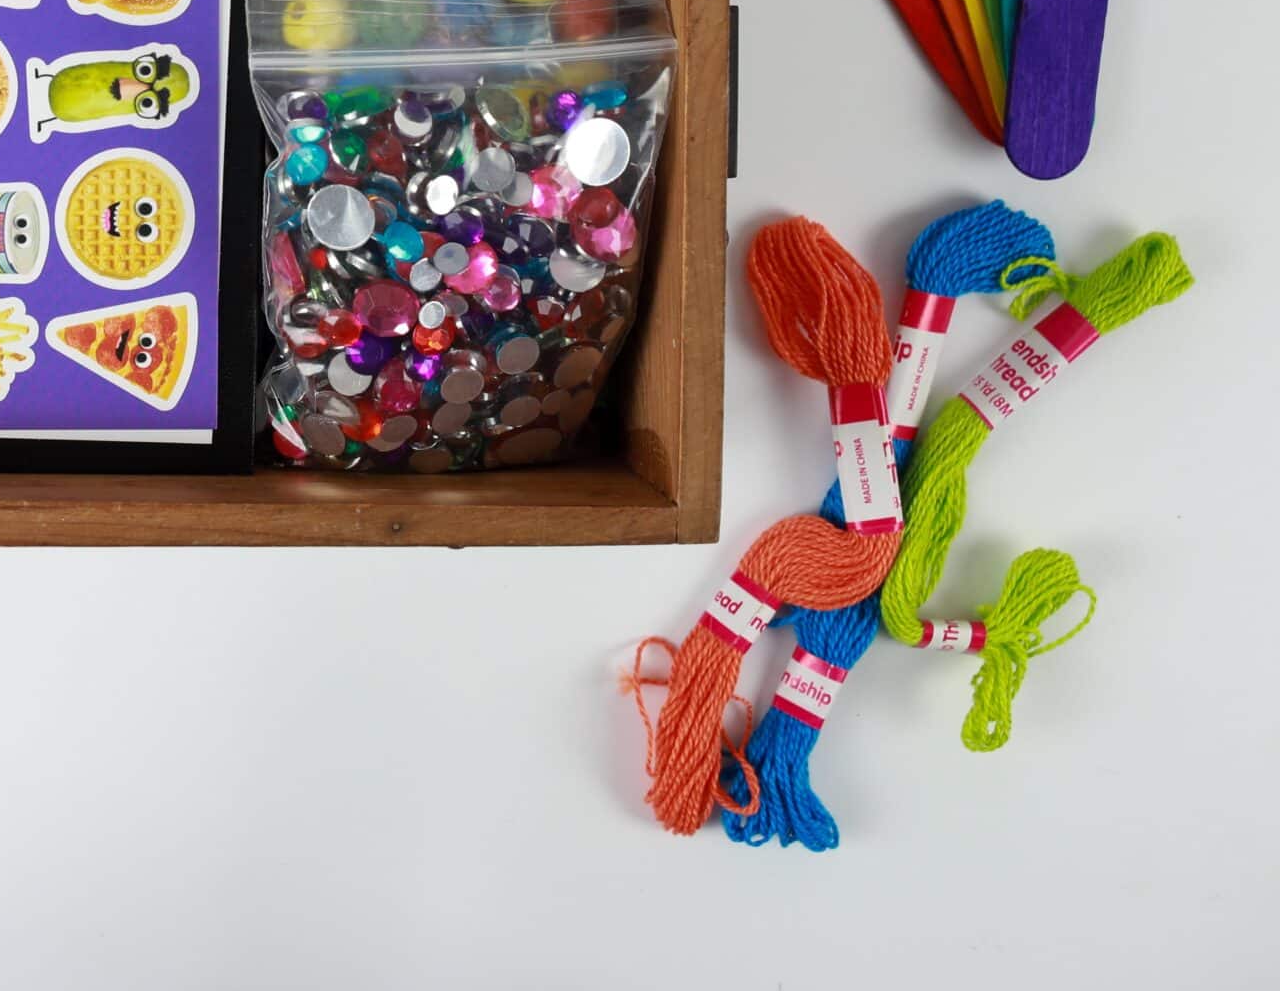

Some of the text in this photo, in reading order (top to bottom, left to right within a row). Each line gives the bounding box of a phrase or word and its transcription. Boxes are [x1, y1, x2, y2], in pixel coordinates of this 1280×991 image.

[907, 347, 929, 410] MADE IN CHINA
[980, 380, 997, 397] Yd
[853, 437, 873, 504] MADE IN CHINA
